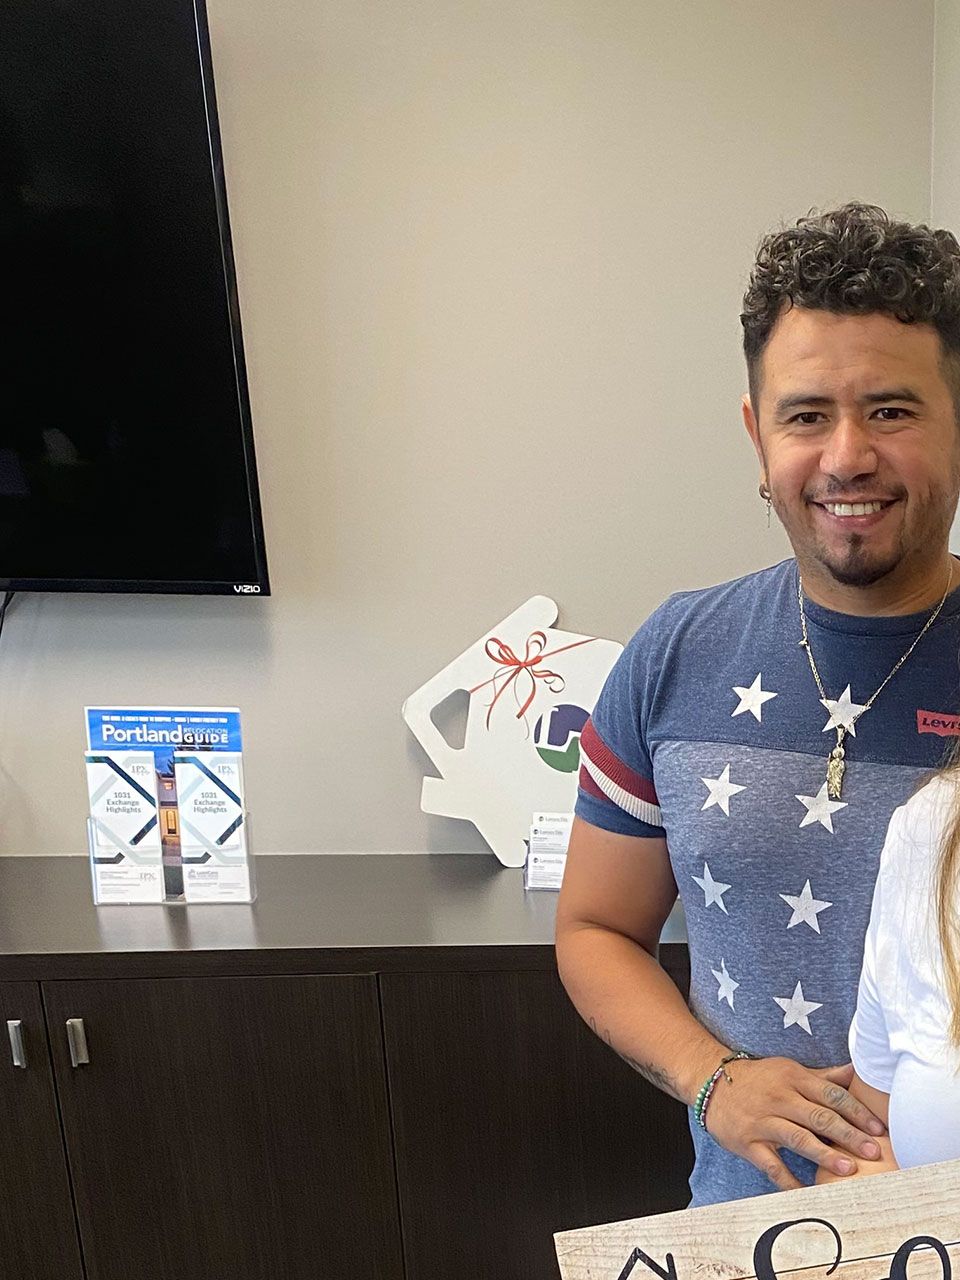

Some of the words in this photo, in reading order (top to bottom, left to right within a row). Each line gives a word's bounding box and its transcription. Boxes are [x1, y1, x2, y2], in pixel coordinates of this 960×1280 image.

[233, 585, 261, 593] VIZIO
[102, 723, 183, 743] Portland
[183, 733, 229, 743] GUIDE
[113, 791, 131, 799] 1031
[200, 791, 217, 799] 1031
[106, 798, 140, 807] Exchange
[193, 798, 226, 807] Exchange
[106, 806, 142, 814] Highlights
[193, 806, 228, 814] Highlights
